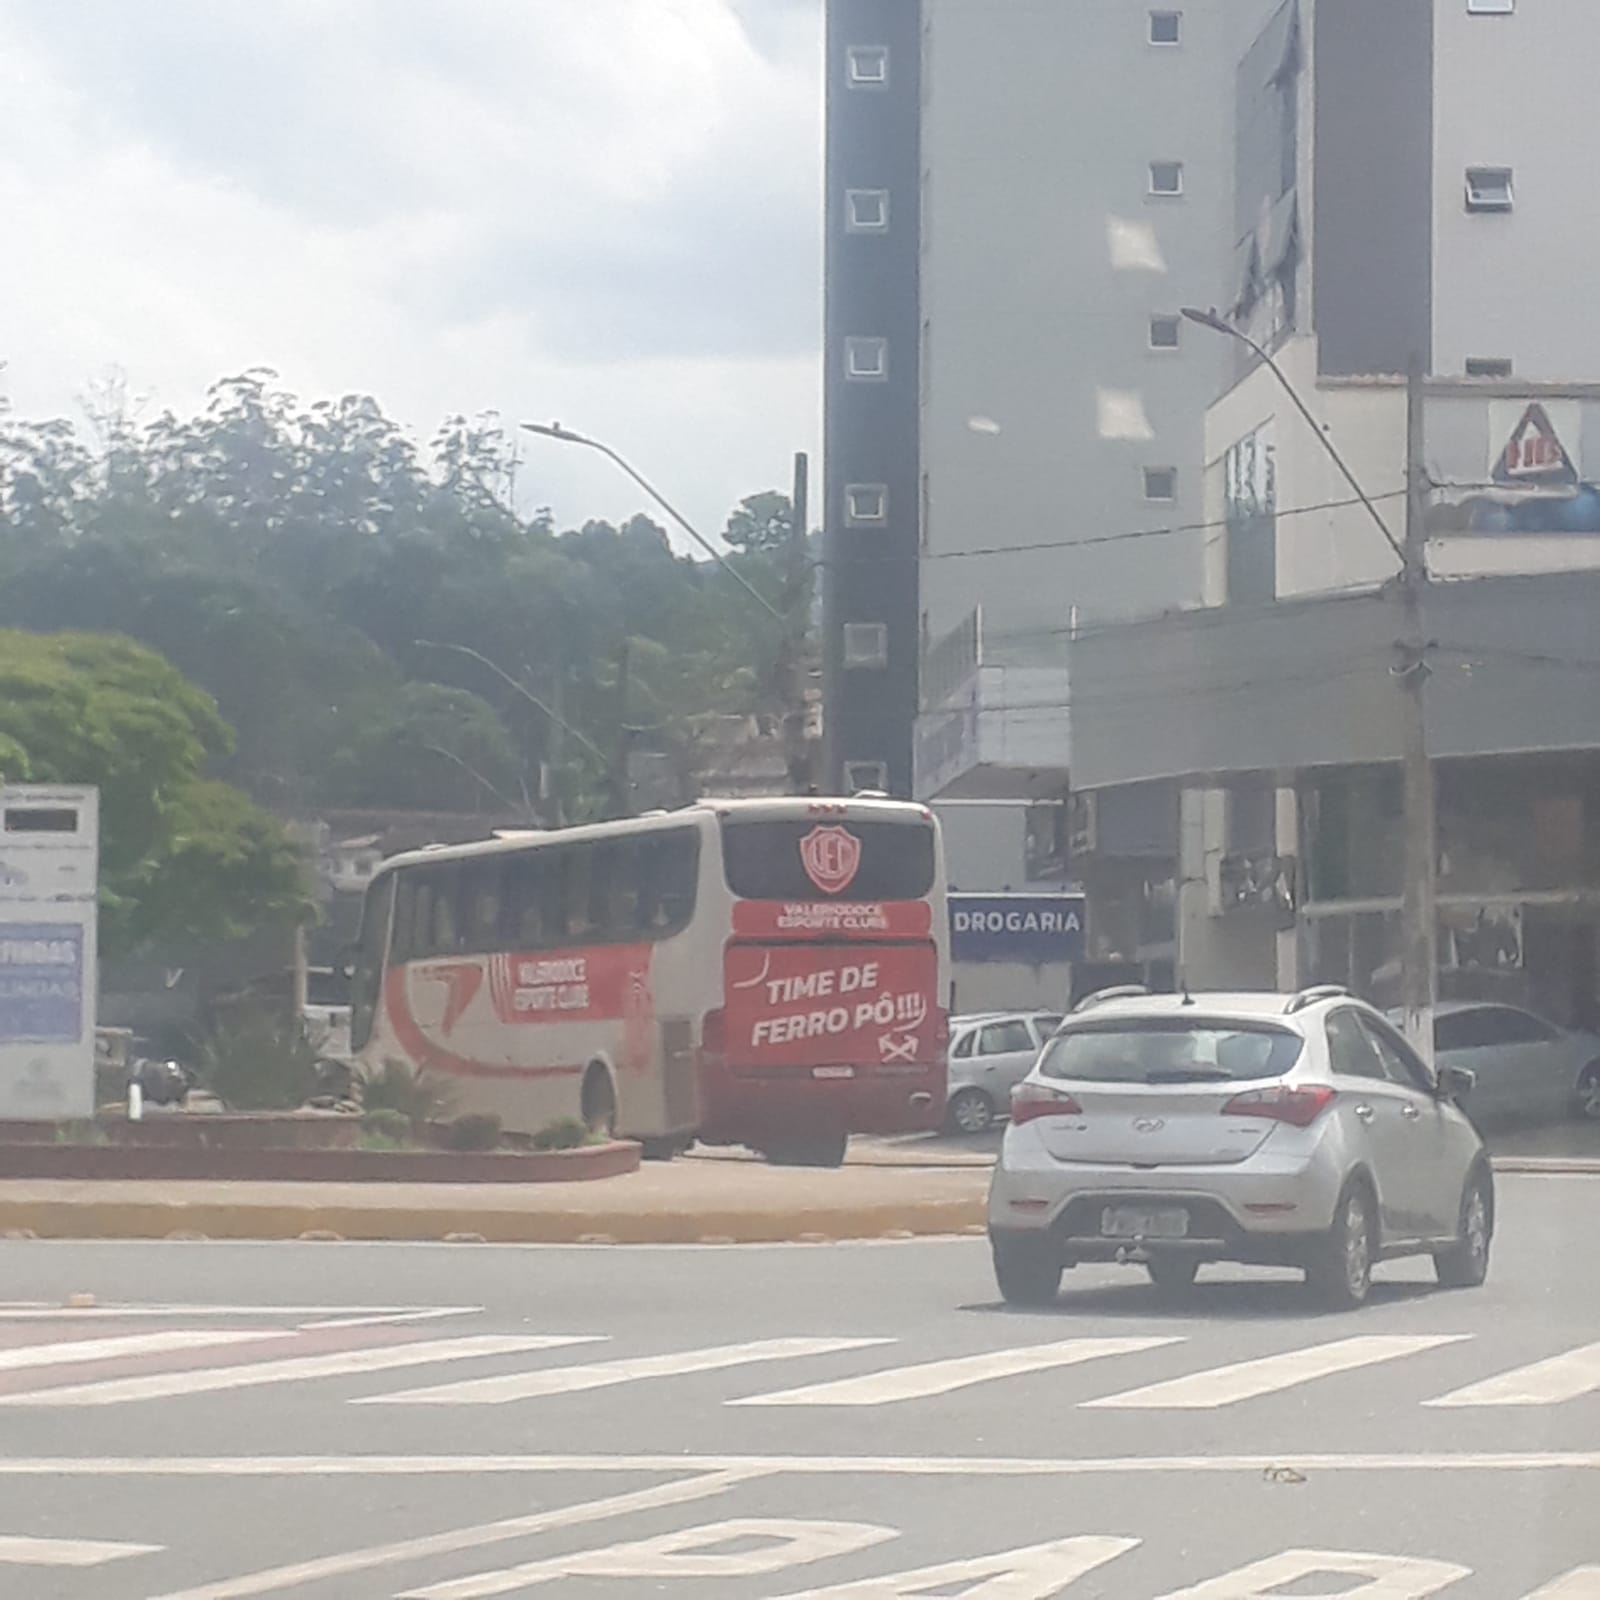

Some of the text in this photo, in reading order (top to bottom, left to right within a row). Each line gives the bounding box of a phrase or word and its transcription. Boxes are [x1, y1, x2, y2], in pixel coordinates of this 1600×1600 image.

[954, 911, 1080, 932] DROGARIA
[766, 962, 879, 1004] TIME DE
[751, 1008, 849, 1047] FERRO
